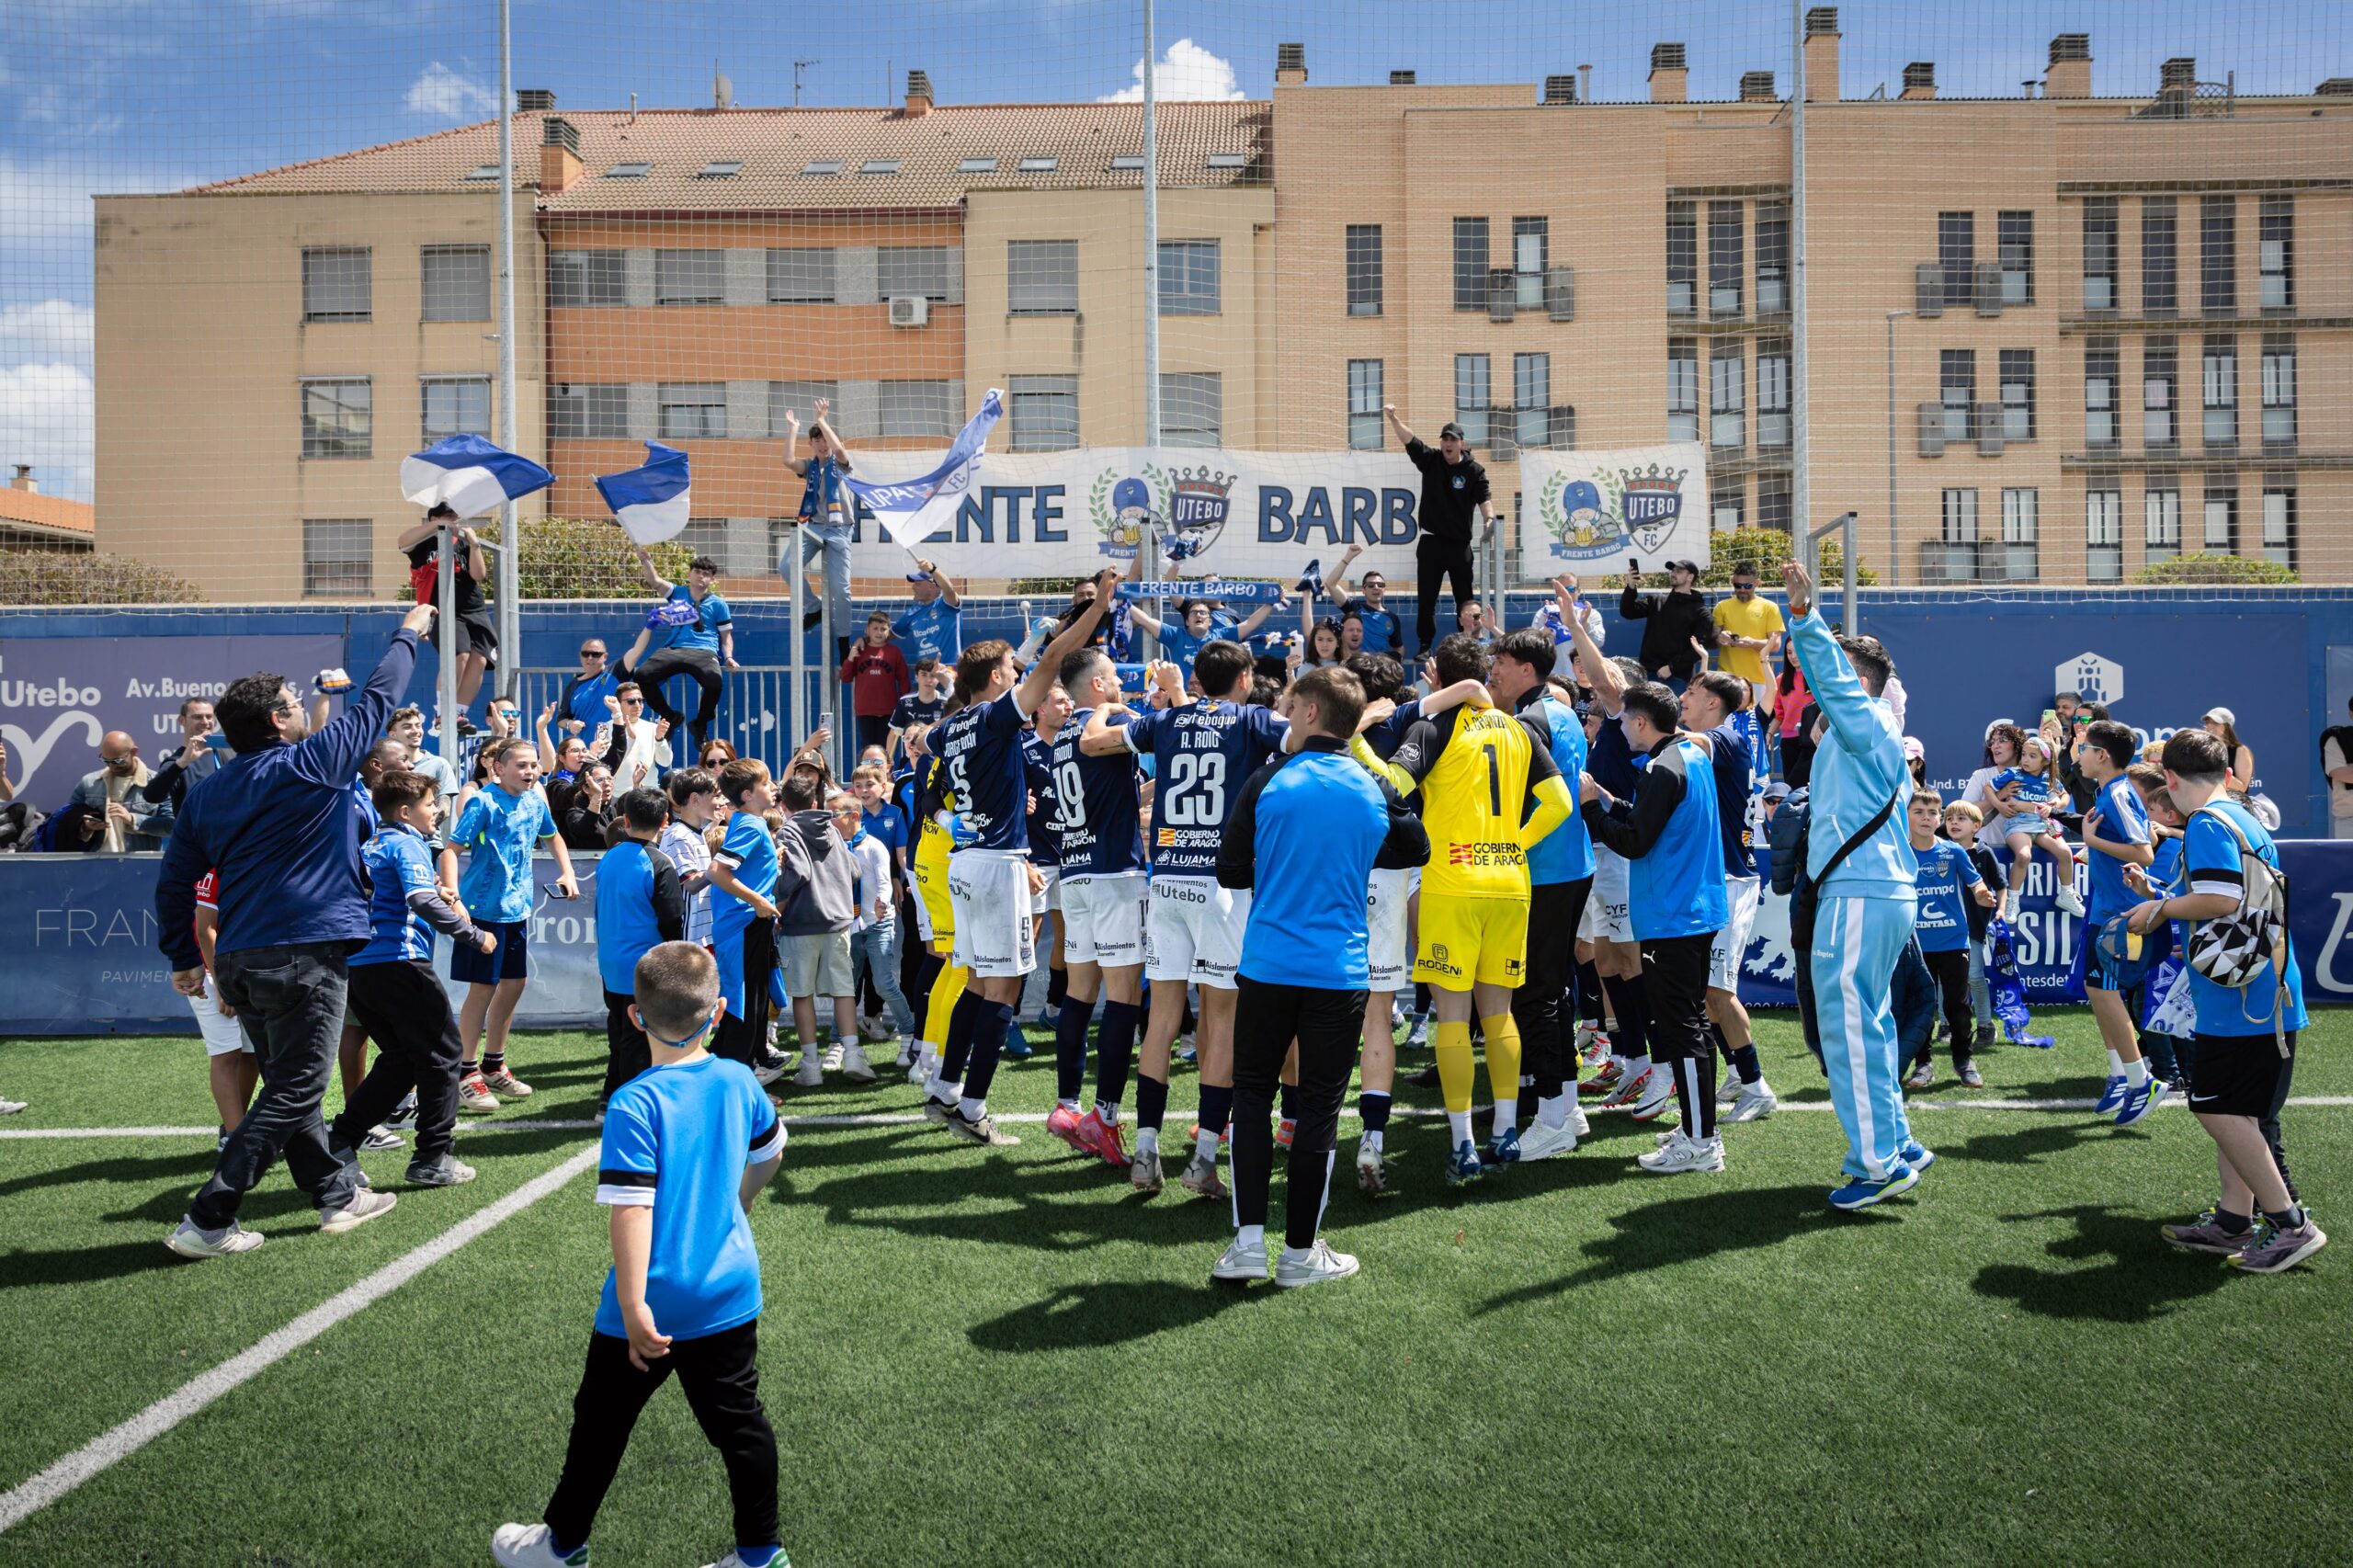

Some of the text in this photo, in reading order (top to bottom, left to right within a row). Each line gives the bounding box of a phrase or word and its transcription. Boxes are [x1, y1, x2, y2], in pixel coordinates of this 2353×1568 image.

[1176, 497, 1222, 521] UTEBO
[1257, 485, 1418, 546] BARB
[1629, 496, 1676, 520] UTEBO
[1643, 534, 1657, 547] FC
[1562, 542, 1621, 558] FRENTE BARBO
[1139, 581, 1257, 597] FRENTE BARBO
[1, 677, 101, 707] Utebo
[126, 677, 232, 699] Av.Bueno
[1181, 732, 1219, 748] A. ROIG
[949, 755, 972, 812] 5
[1483, 744, 1501, 816] 1
[1052, 761, 1086, 827] 19
[1165, 753, 1226, 825] 23
[1046, 822, 1066, 831] CINT
[1176, 830, 1220, 839] GOBIERNO
[1176, 839, 1187, 847] DE
[1473, 843, 1521, 854] GOBIERN
[1061, 852, 1092, 867] LJAMA
[1172, 854, 1216, 867] LUJAMA
[1474, 855, 1526, 866] DE ARAG
[1161, 885, 1207, 903] Utebo
[1915, 884, 1955, 897] campo
[1606, 903, 1627, 915] CYF
[1021, 916, 1029, 942] 5
[1098, 941, 1136, 950] Aislamientos
[976, 955, 1012, 963] Aislamientos
[1710, 949, 1725, 958] YF
[1205, 960, 1238, 972] Aislamient
